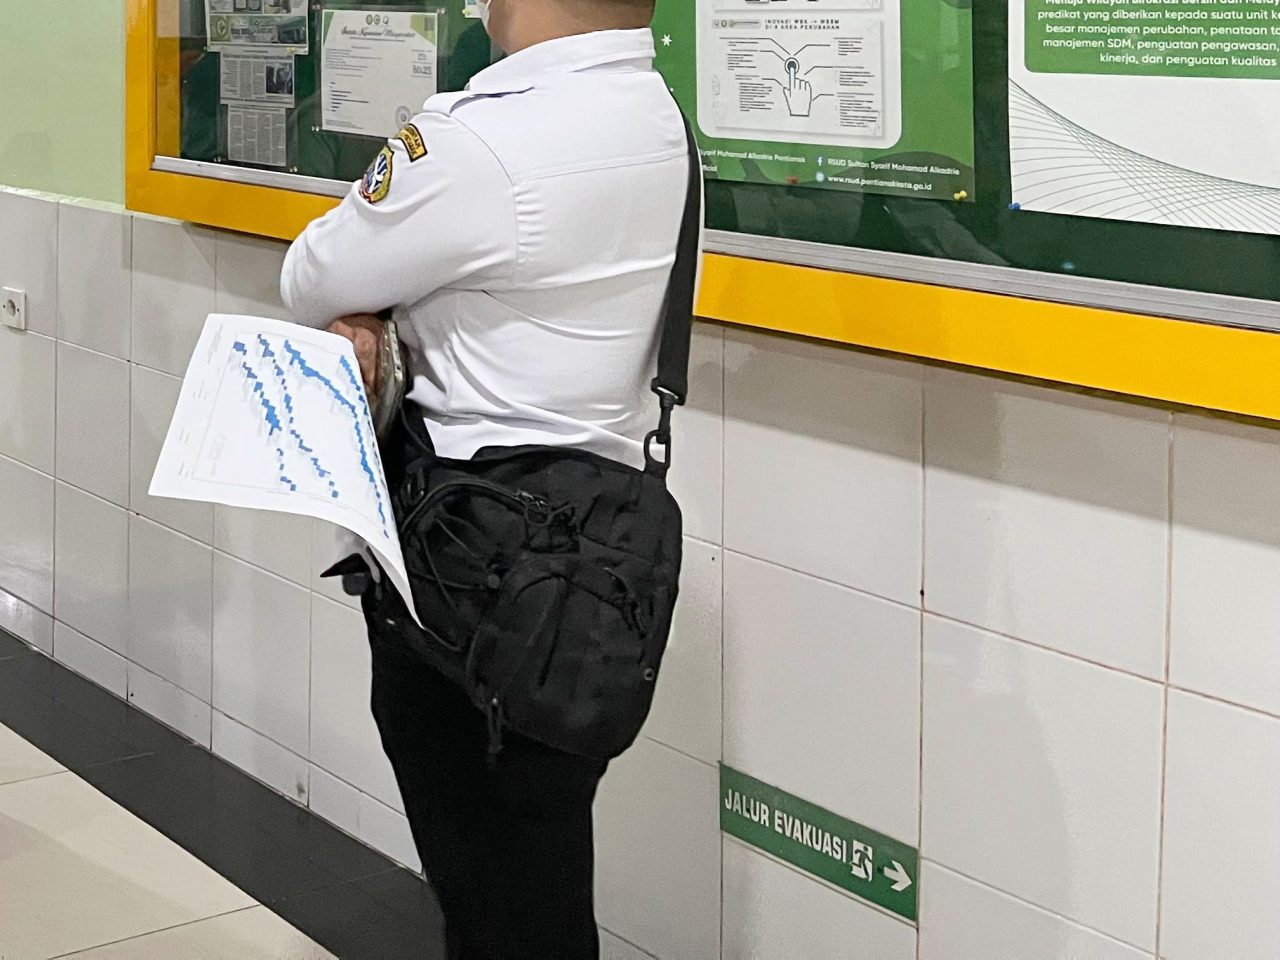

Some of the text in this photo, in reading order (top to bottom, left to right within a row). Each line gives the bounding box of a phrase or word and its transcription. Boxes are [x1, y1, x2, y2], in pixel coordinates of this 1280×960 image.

[1038, 10, 1081, 21] predikat
[1083, 10, 1110, 22] yang
[1112, 9, 1162, 20] diberikan
[1165, 10, 1208, 21] kepada
[1211, 10, 1243, 20] suatu
[1246, 10, 1269, 20] unit
[1046, 24, 1075, 34] besar
[1078, 25, 1140, 36] manajemen
[1143, 25, 1207, 36] perubahan,
[1210, 26, 1268, 37] penataan
[1043, 38, 1280, 53] manajemen SDM, penguatan pengawasan,
[1100, 53, 1277, 67] kinerja, dan penguatan kualitas
[827, 158, 960, 176] RSUD Sultan Syarif Mohamad Alkadrie
[724, 789, 847, 864] JALUR EVAKUASI
